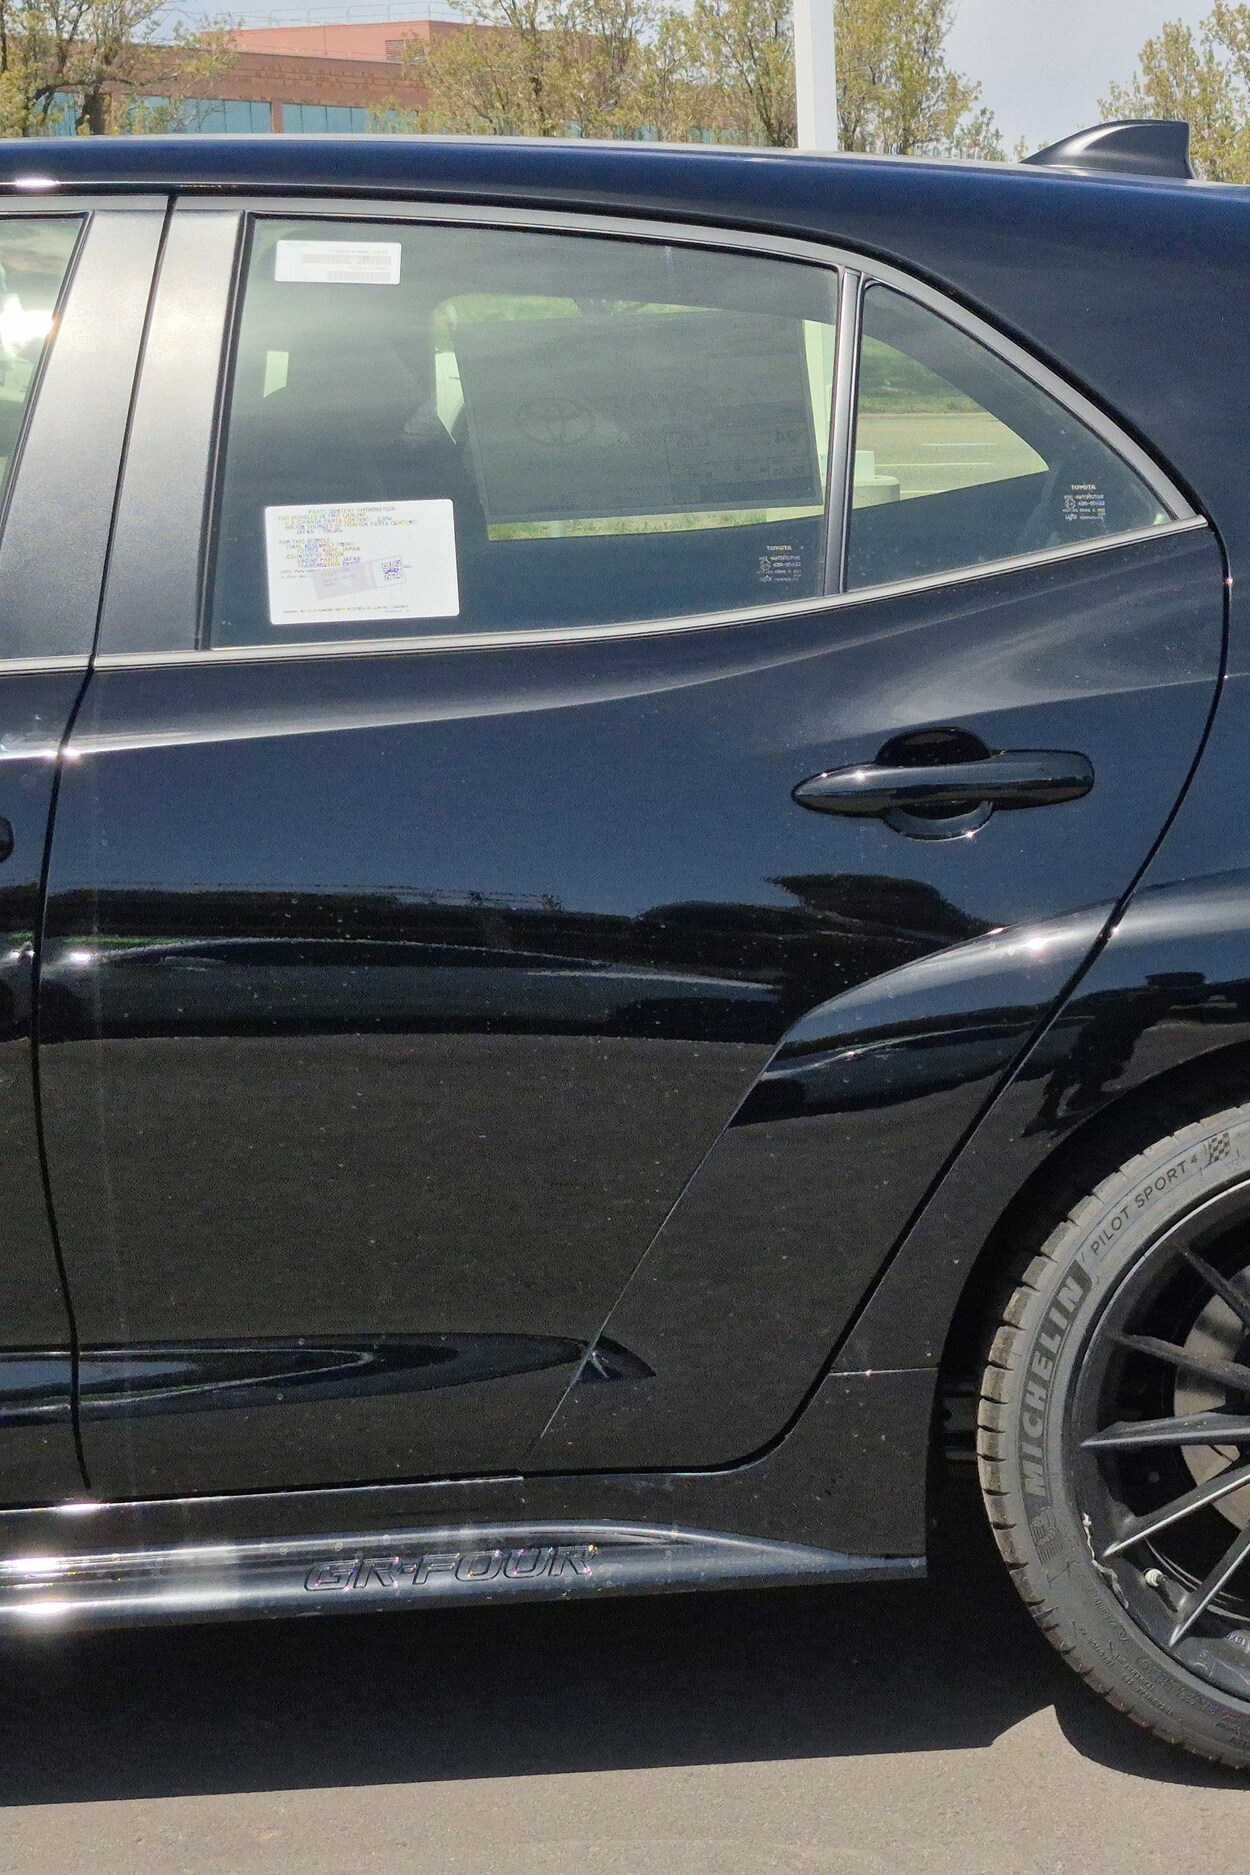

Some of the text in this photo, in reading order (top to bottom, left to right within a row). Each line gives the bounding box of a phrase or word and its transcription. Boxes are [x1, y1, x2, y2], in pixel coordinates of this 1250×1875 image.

[1090, 1153, 1199, 1256] PILOT SPORT 4
[1021, 1274, 1085, 1498] MICHELIN
